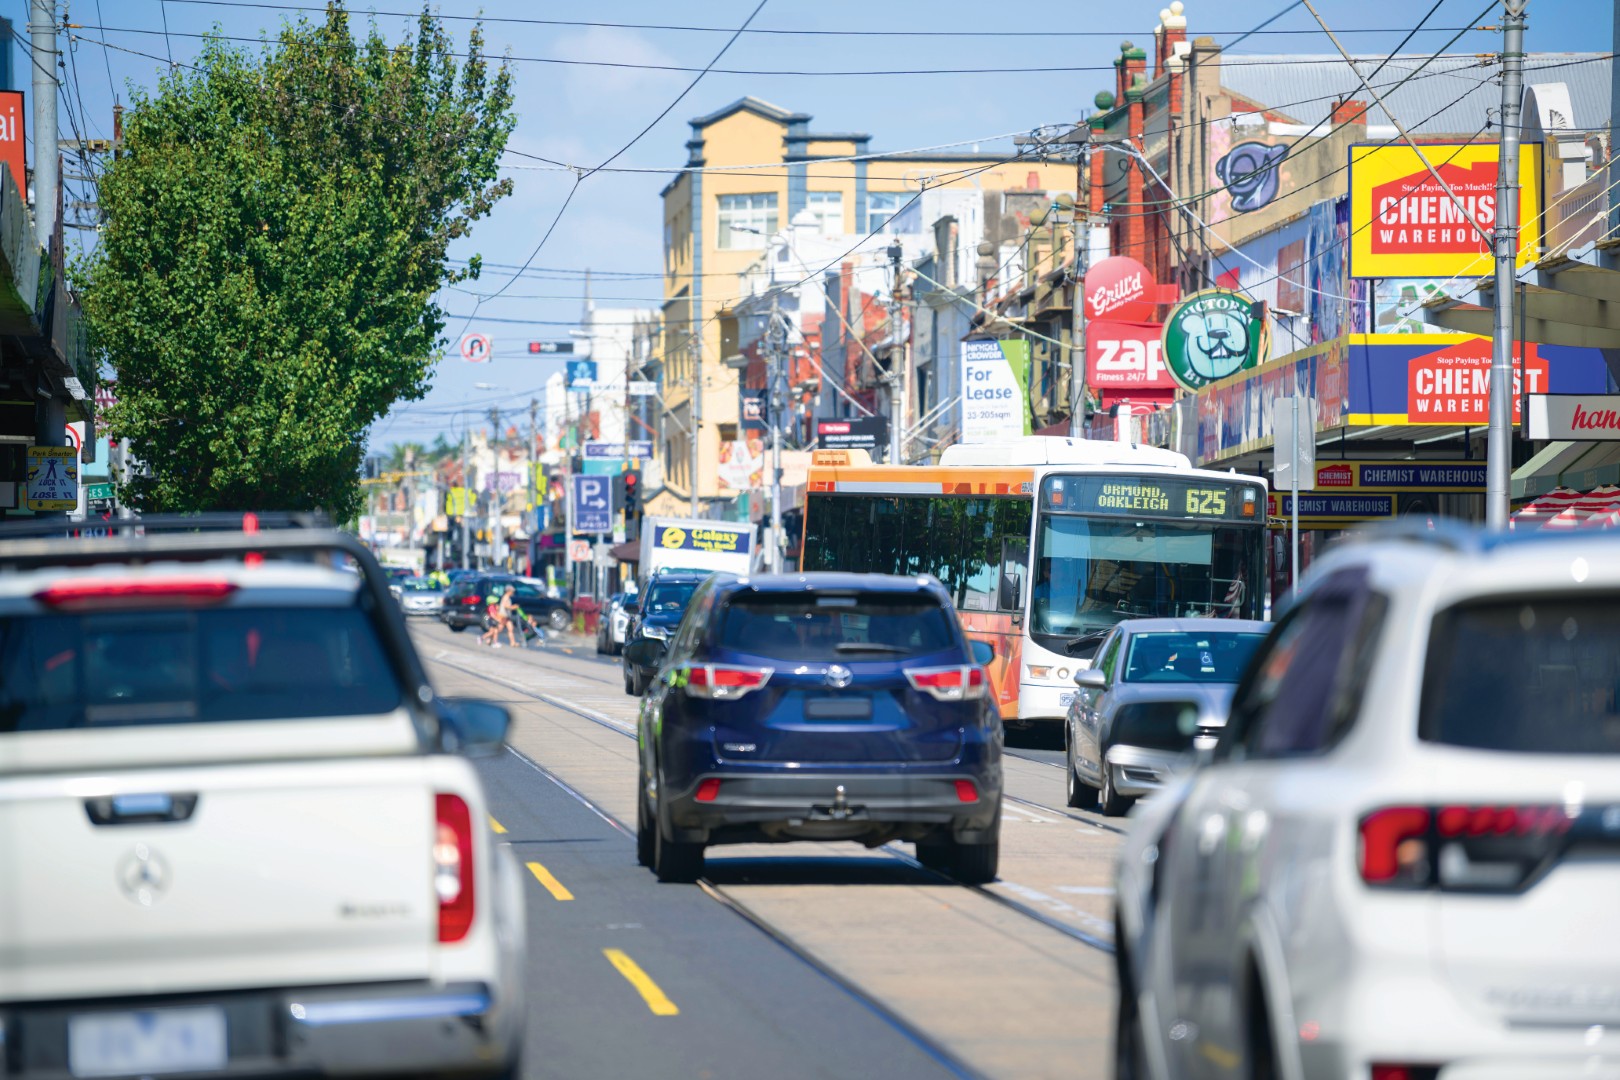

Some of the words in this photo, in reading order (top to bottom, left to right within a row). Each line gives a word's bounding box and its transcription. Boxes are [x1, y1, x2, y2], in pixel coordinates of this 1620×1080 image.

[1402, 184, 1419, 192] Stop
[1379, 195, 1496, 225] CHEMIS
[1087, 271, 1143, 316] Grill'd
[1096, 339, 1166, 380] zap
[1437, 356, 1453, 365] Stop
[1455, 356, 1480, 366] Paying
[966, 366, 992, 381] For
[1096, 373, 1124, 381] Fitness
[1126, 372, 1146, 382] 24/7
[966, 385, 1012, 400] Lease
[1571, 403, 1620, 431] han
[48, 449, 72, 457] Smarter
[1319, 471, 1352, 480] CHEMIST
[1364, 469, 1415, 482] CHEMIST
[1098, 495, 1169, 511] OAKLEIGH
[1185, 489, 1227, 515] 625
[1285, 500, 1327, 512] CEMIST
[1331, 500, 1389, 512] WAREHOUSE
[691, 529, 738, 543] Galaxy
